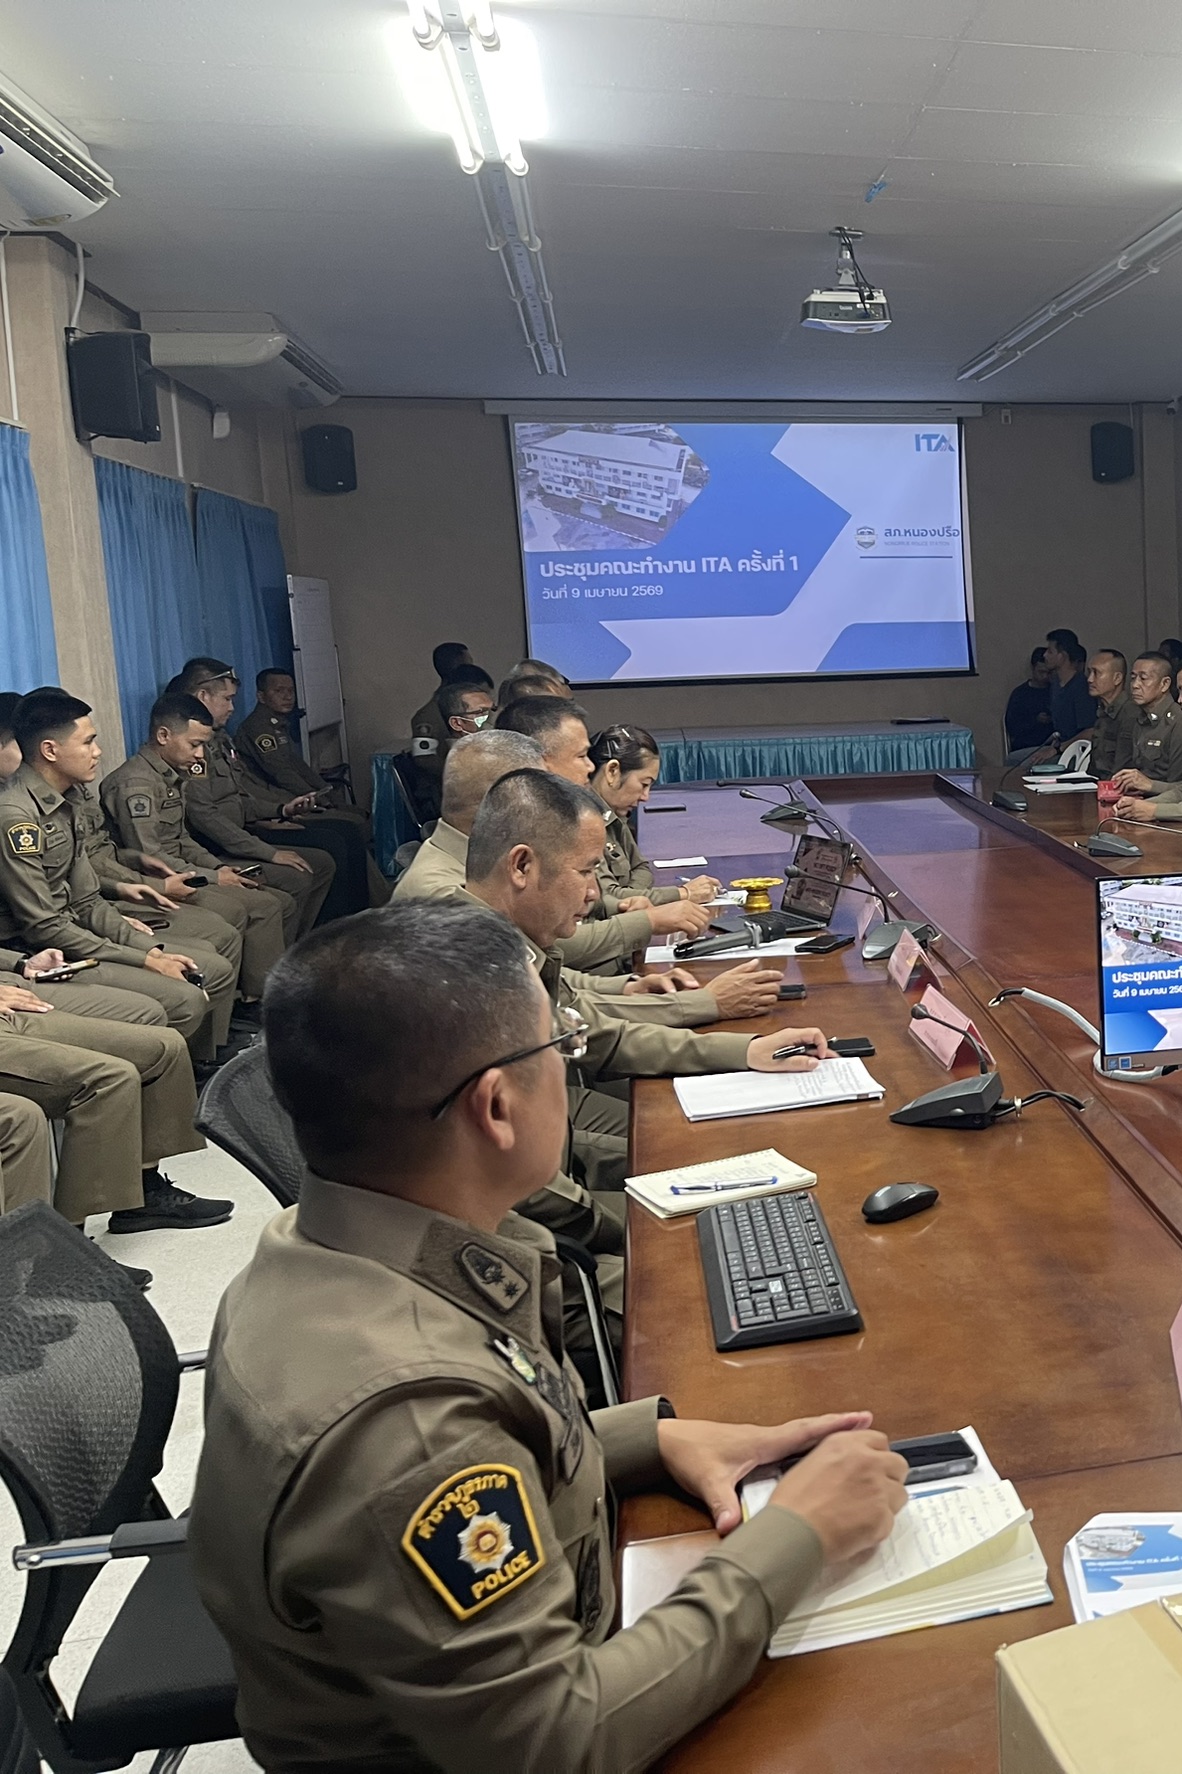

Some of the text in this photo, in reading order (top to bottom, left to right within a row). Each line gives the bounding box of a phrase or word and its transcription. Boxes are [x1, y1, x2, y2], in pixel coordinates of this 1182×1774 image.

[915, 433, 955, 452] ITA
[884, 525, 960, 538] สภ.หนองปรือ
[540, 549, 799, 582] ประชุมคณะทำงาน ITA ครั้งที่ 1
[542, 584, 664, 600] วันที่ 9 เมษายน 2569
[1113, 987, 1130, 998] วันที่
[471, 1550, 532, 1600] POLICE
